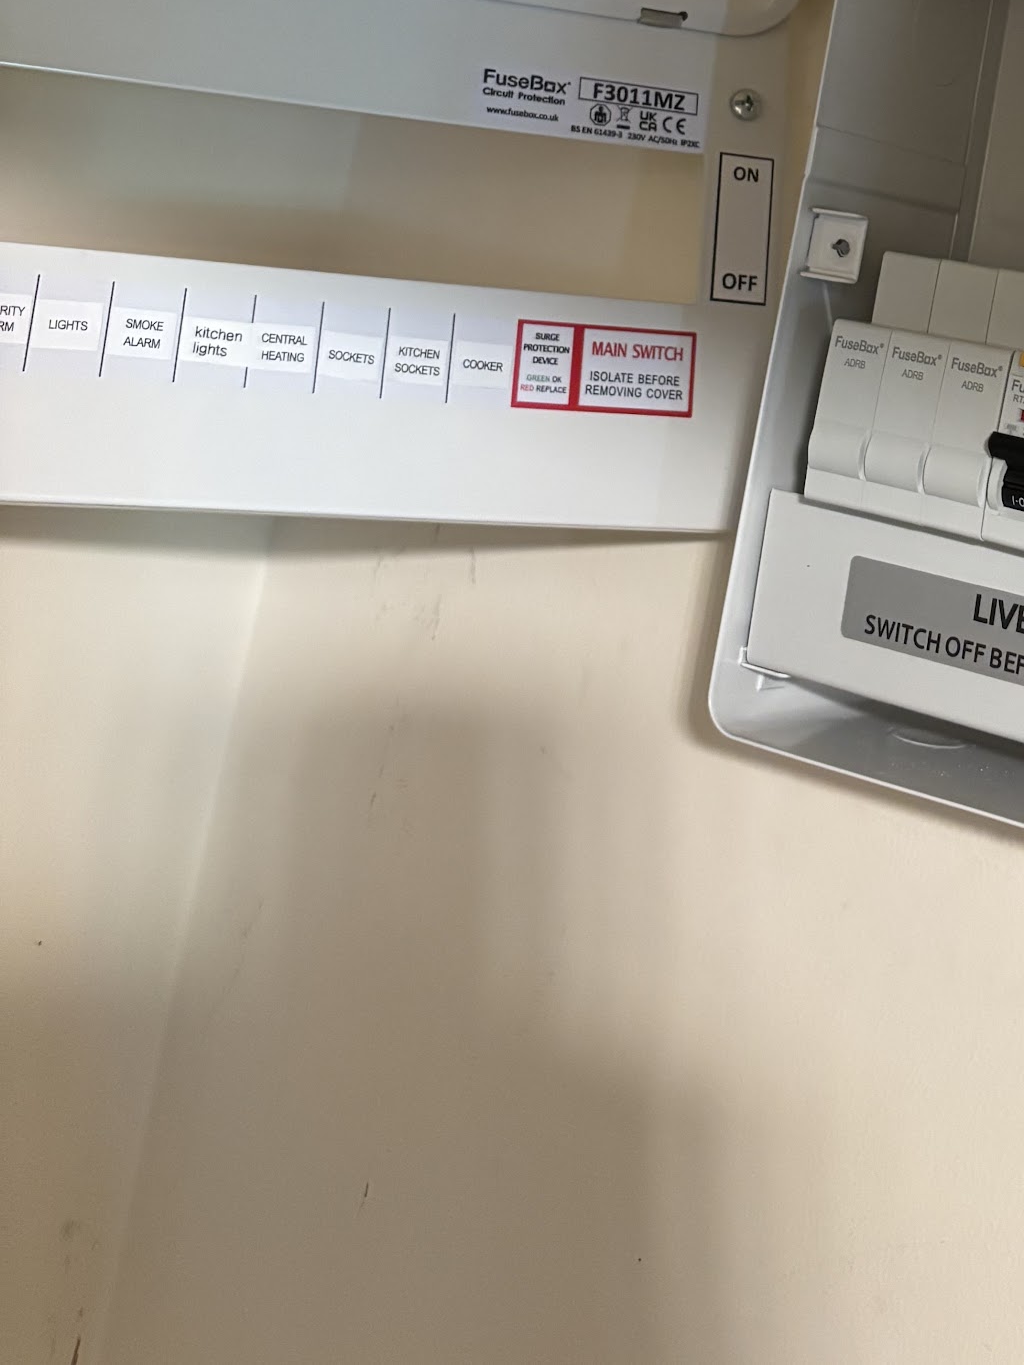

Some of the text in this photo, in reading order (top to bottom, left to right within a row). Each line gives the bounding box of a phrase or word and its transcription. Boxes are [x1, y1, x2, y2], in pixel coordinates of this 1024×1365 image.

[483, 87, 514, 98] Circuit
[518, 92, 565, 105] Protection
[593, 83, 686, 111] F3011MZ
[486, 106, 559, 122] www.fusebox.co.uk
[733, 167, 759, 182] ON
[722, 273, 758, 292] OFF
[48, 319, 88, 331] LIGHTS
[125, 318, 164, 332] SMOKE
[195, 325, 243, 342] kitchen
[261, 332, 307, 346] CENTRAL
[536, 333, 560, 341] SURGE
[123, 337, 161, 349] ALARM
[192, 341, 227, 358] lights
[523, 344, 570, 353] PROTECTION
[261, 350, 305, 363] HEATING
[328, 349, 374, 365] SOCKETS
[398, 346, 440, 360] KITCHEN
[592, 341, 683, 361] MAIN SWITCH
[463, 359, 503, 372] COOKER
[533, 356, 558, 365] DEVICE
[394, 363, 440, 376] SOCKETS
[526, 374, 550, 382] GREEN
[590, 371, 680, 387] ISOLATE BEFORE
[585, 385, 682, 400] REMOVING COVER
[864, 614, 941, 653] SWITCH
[945, 636, 985, 664] OFF
